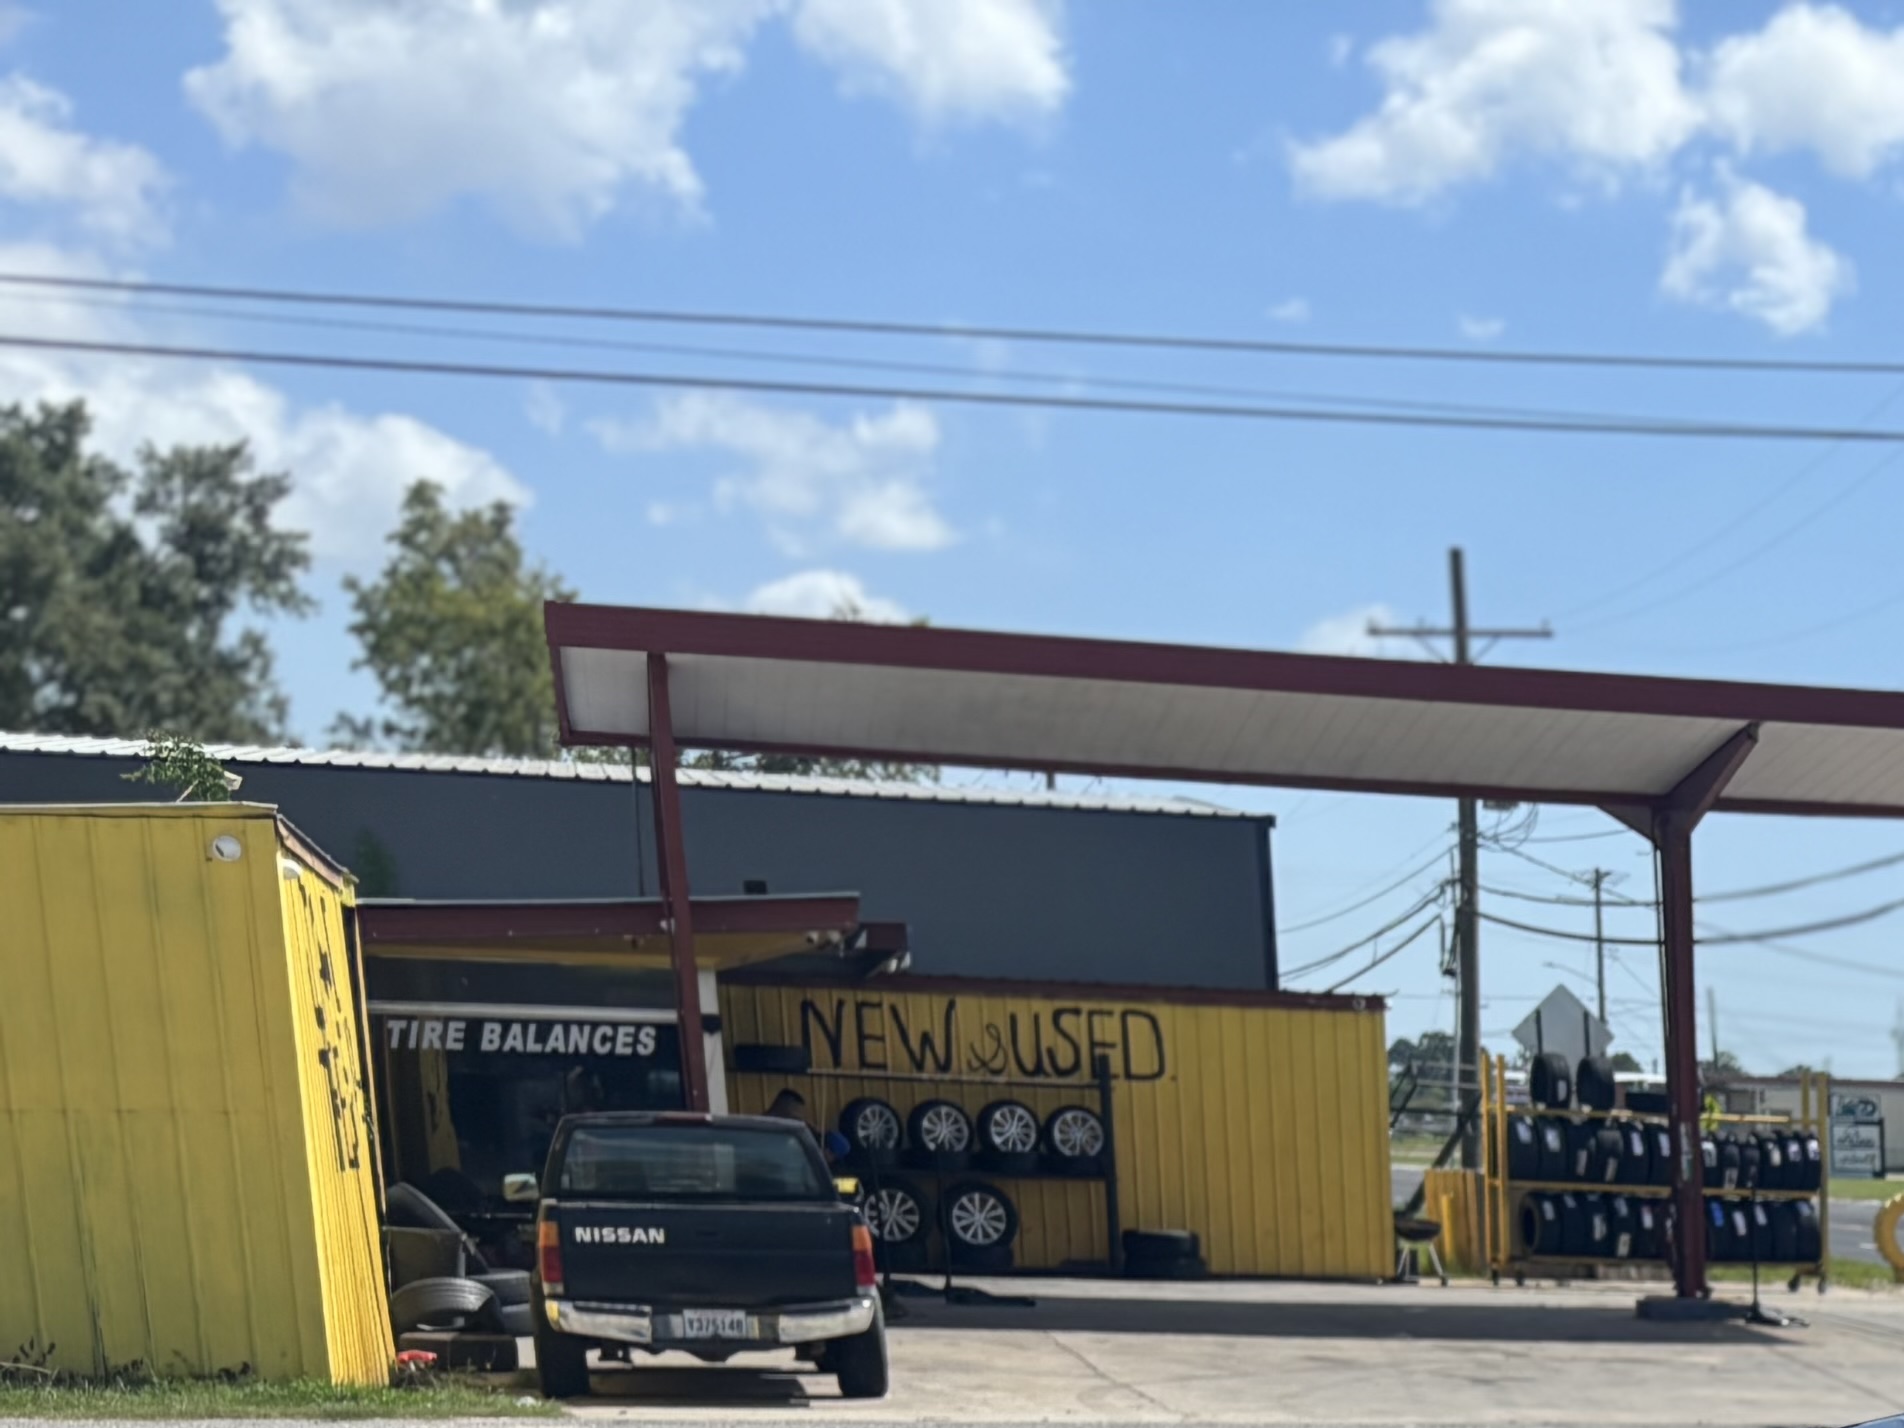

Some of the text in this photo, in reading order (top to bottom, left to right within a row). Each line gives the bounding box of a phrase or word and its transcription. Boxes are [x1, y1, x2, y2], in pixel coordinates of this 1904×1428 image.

[387, 1020, 657, 1056] TIRE BALANCES
[801, 998, 956, 1074] NEW
[575, 1227, 665, 1244] NISSAN
